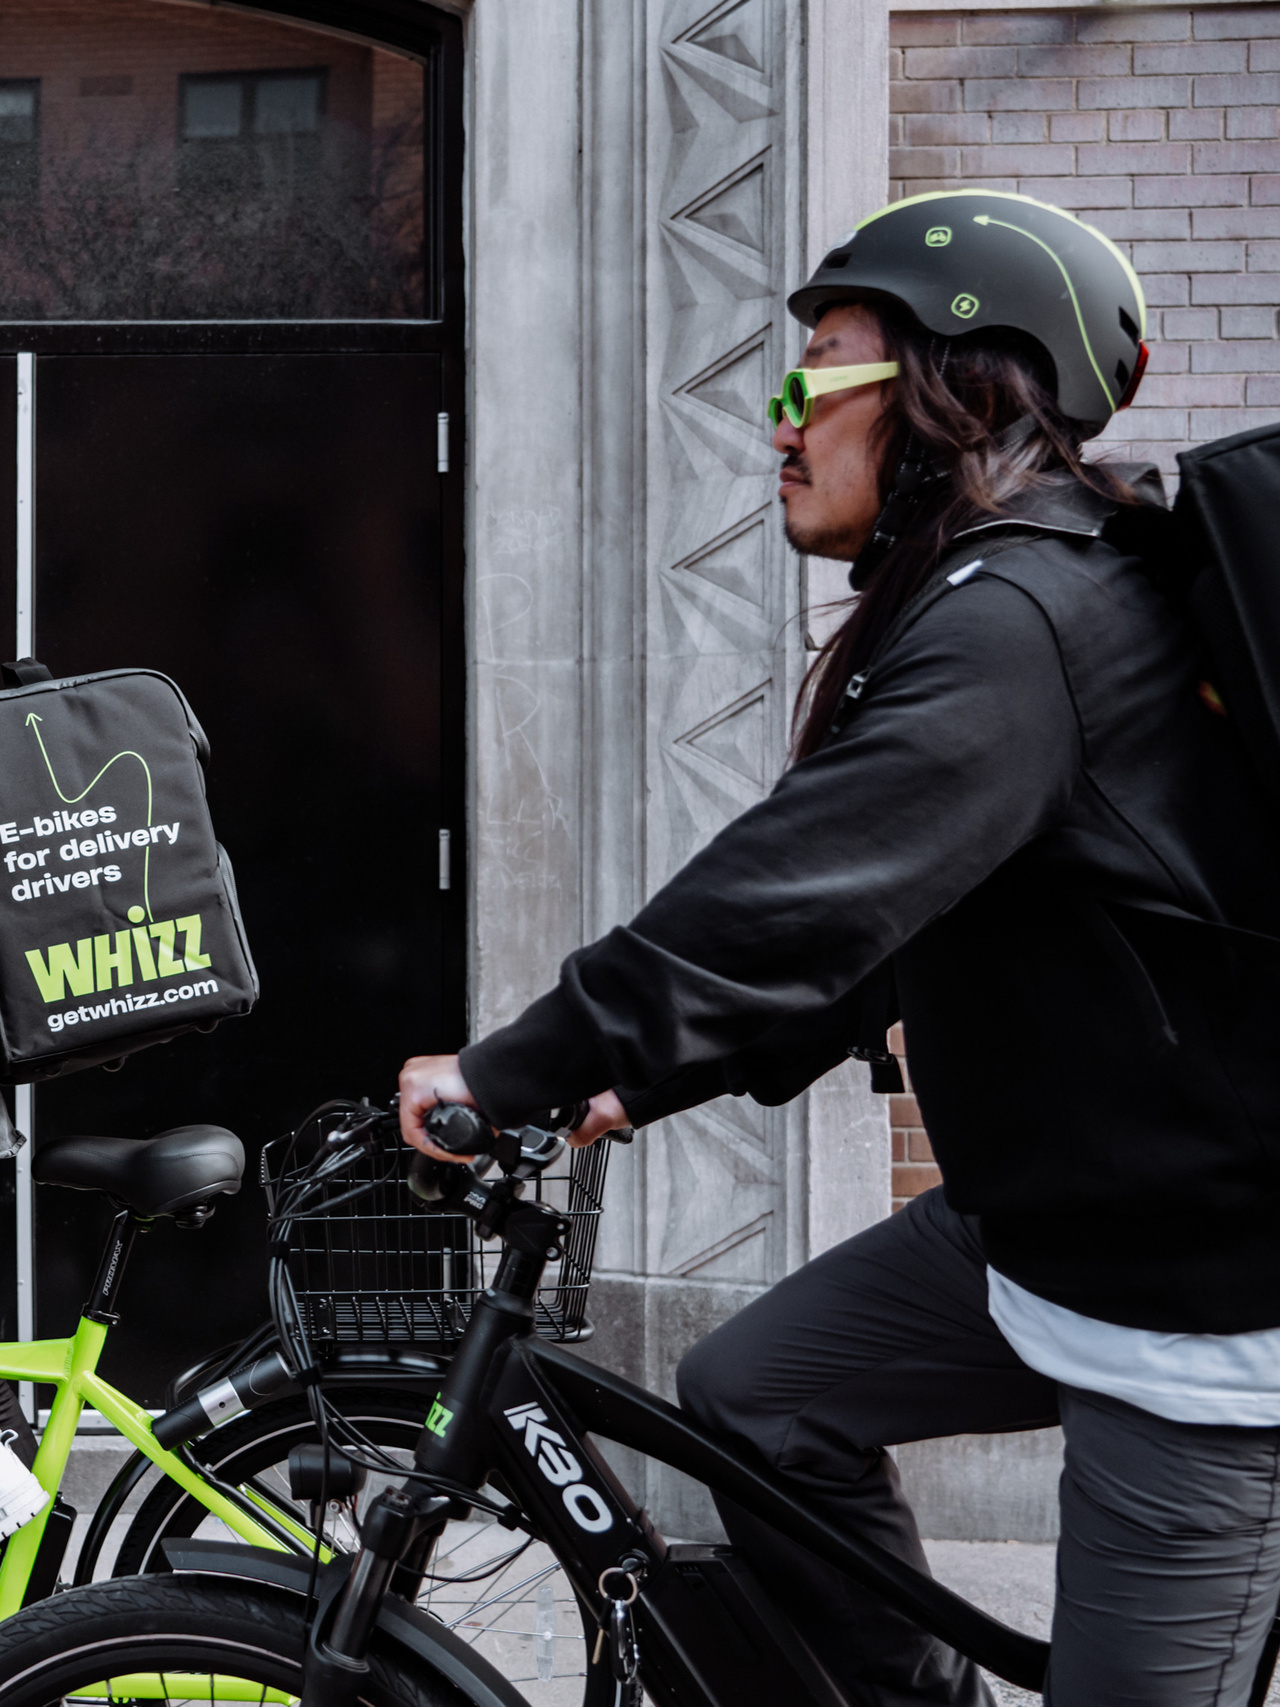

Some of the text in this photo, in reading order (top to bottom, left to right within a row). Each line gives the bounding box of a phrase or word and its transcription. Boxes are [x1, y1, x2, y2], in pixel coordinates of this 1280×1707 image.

[3, 821, 181, 874] for delivery
[10, 863, 123, 902] drivers
[46, 978, 220, 1033] getwhizz.com
